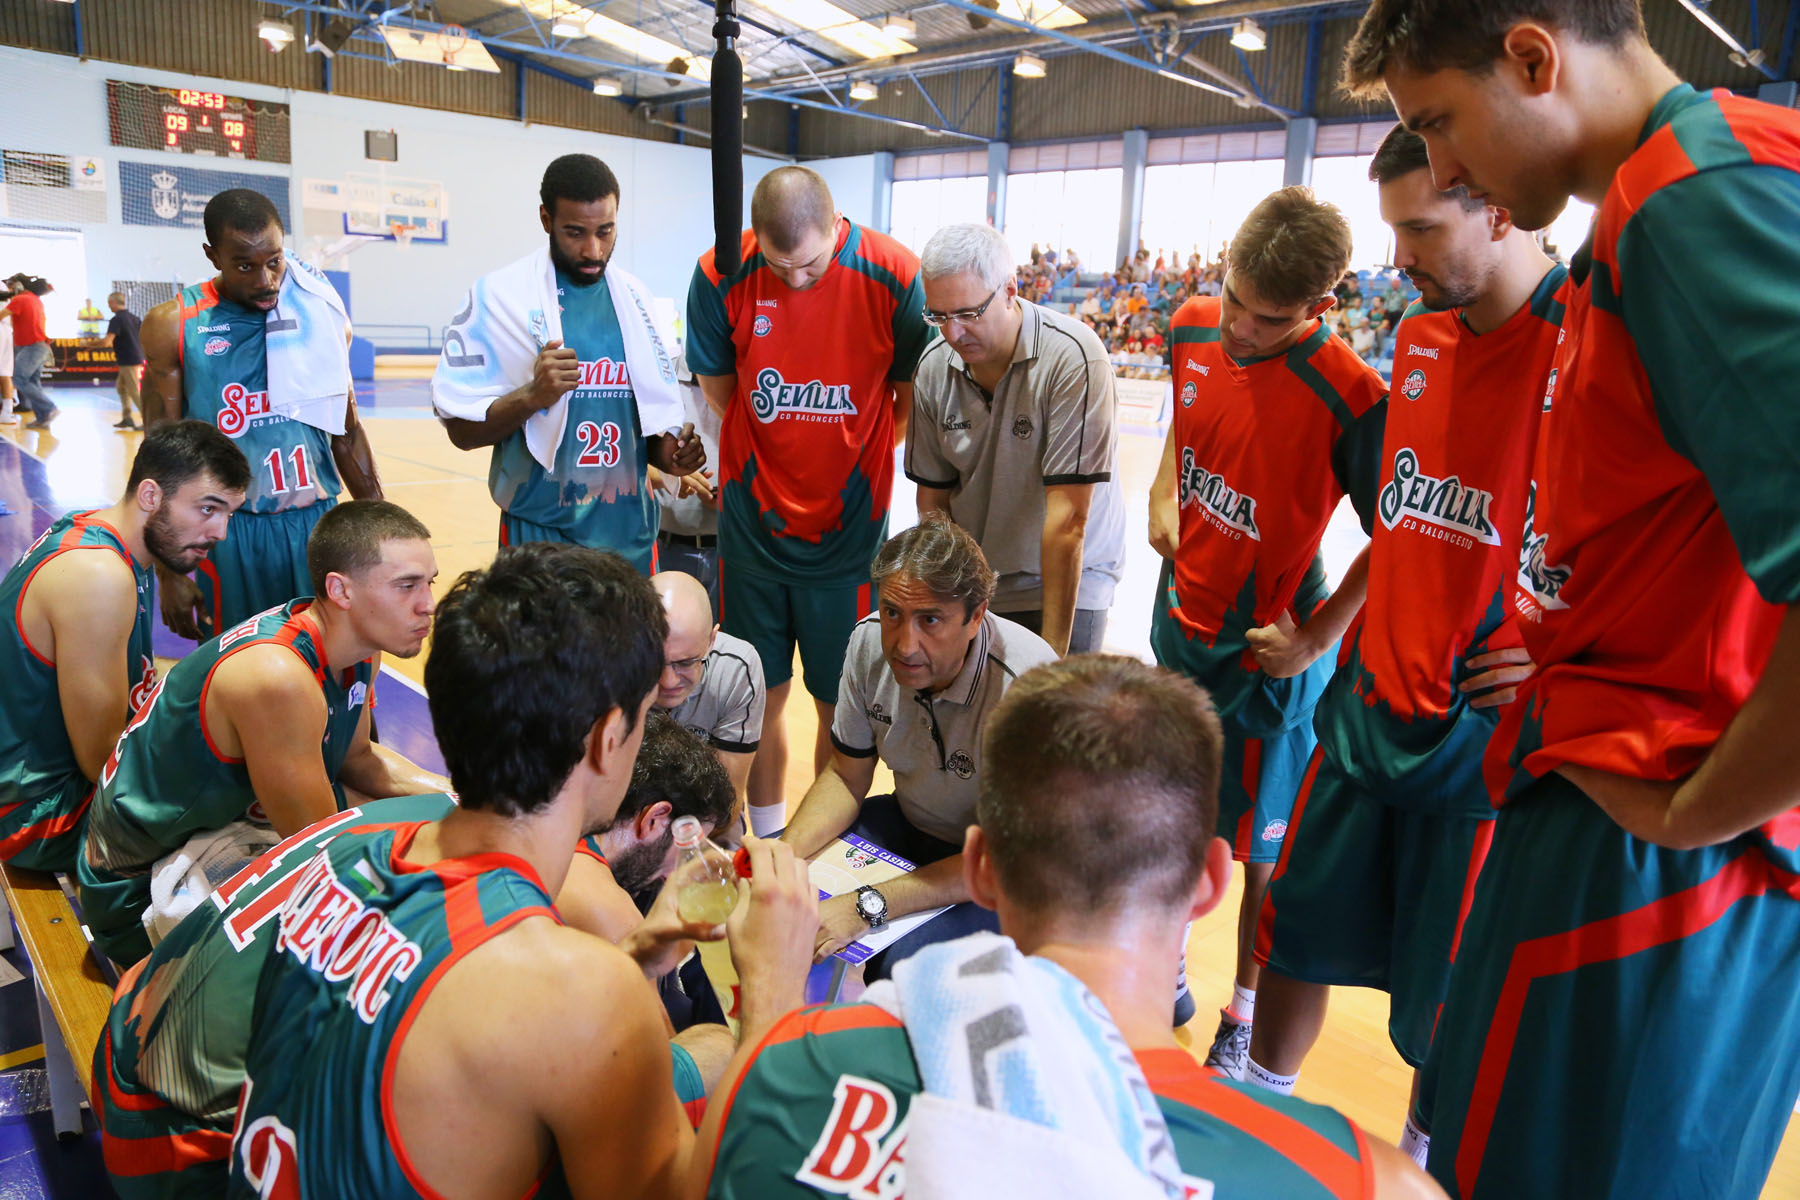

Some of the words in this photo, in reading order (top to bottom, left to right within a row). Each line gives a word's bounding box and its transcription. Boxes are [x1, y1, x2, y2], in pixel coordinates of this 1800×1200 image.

[180, 89, 225, 109] 02:53
[166, 114, 188, 131] 09
[224, 121, 245, 137] 08
[197, 323, 231, 334] SPALDING
[1408, 344, 1439, 360] SPALDING
[750, 367, 858, 424] SEVILLA
[576, 421, 621, 468] 23
[263, 444, 314, 495] 11
[1181, 446, 1261, 542] SEVILLA
[1378, 447, 1502, 547] SEVILLA
[1402, 519, 1417, 531] CD
[1419, 524, 1474, 550] BALONCESTO
[856, 840, 879, 854] LUIS
